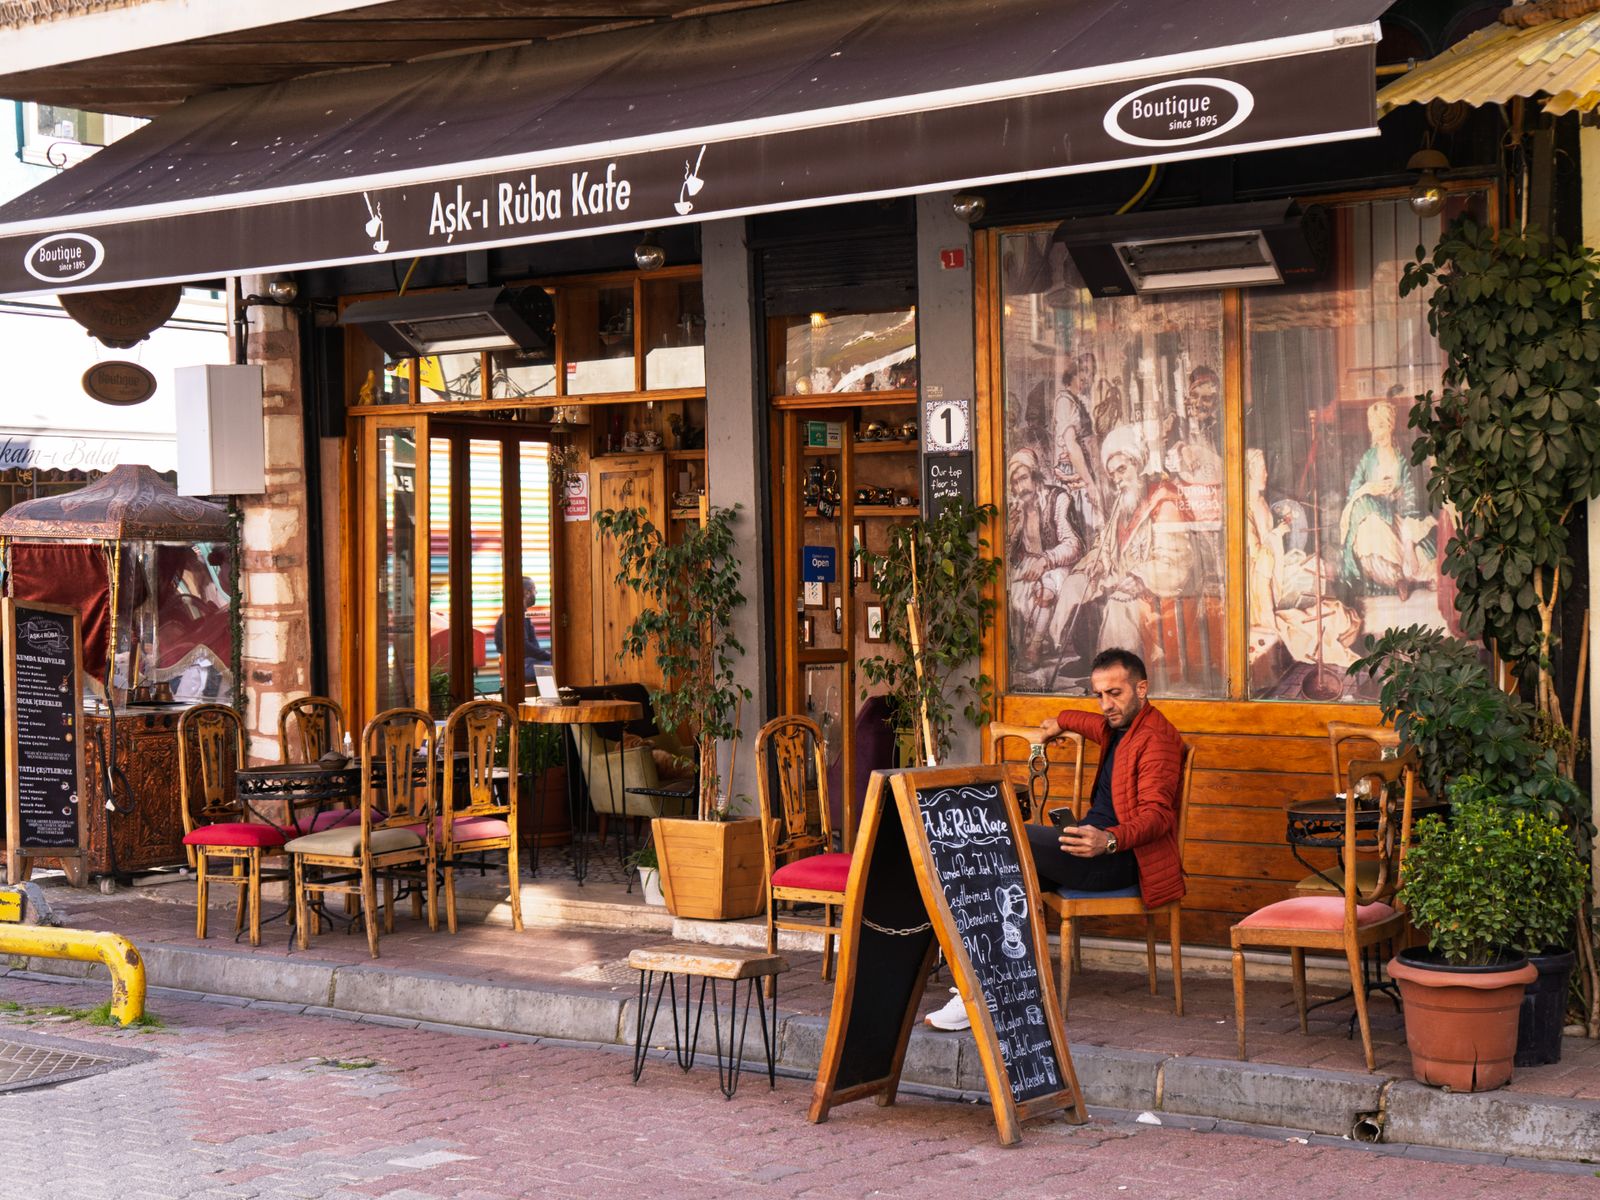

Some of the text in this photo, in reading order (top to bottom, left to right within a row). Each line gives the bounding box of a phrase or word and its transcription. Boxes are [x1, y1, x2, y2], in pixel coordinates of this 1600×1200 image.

[1132, 95, 1211, 119] Boutique
[1168, 114, 1218, 130] since 1895
[429, 163, 631, 243] Aşk-ı Rûba Kafe
[39, 246, 82, 263] Boutique
[949, 252, 956, 266] 1
[59, 260, 86, 271] since 1895
[940, 407, 952, 444] 1
[62, 439, 120, 466] Balat
[931, 465, 962, 479] Our top
[930, 478, 949, 490] floor
[811, 558, 830, 568] Open
[16, 654, 66, 666] KUMDA KAHVELER
[17, 697, 33, 706] SICAK
